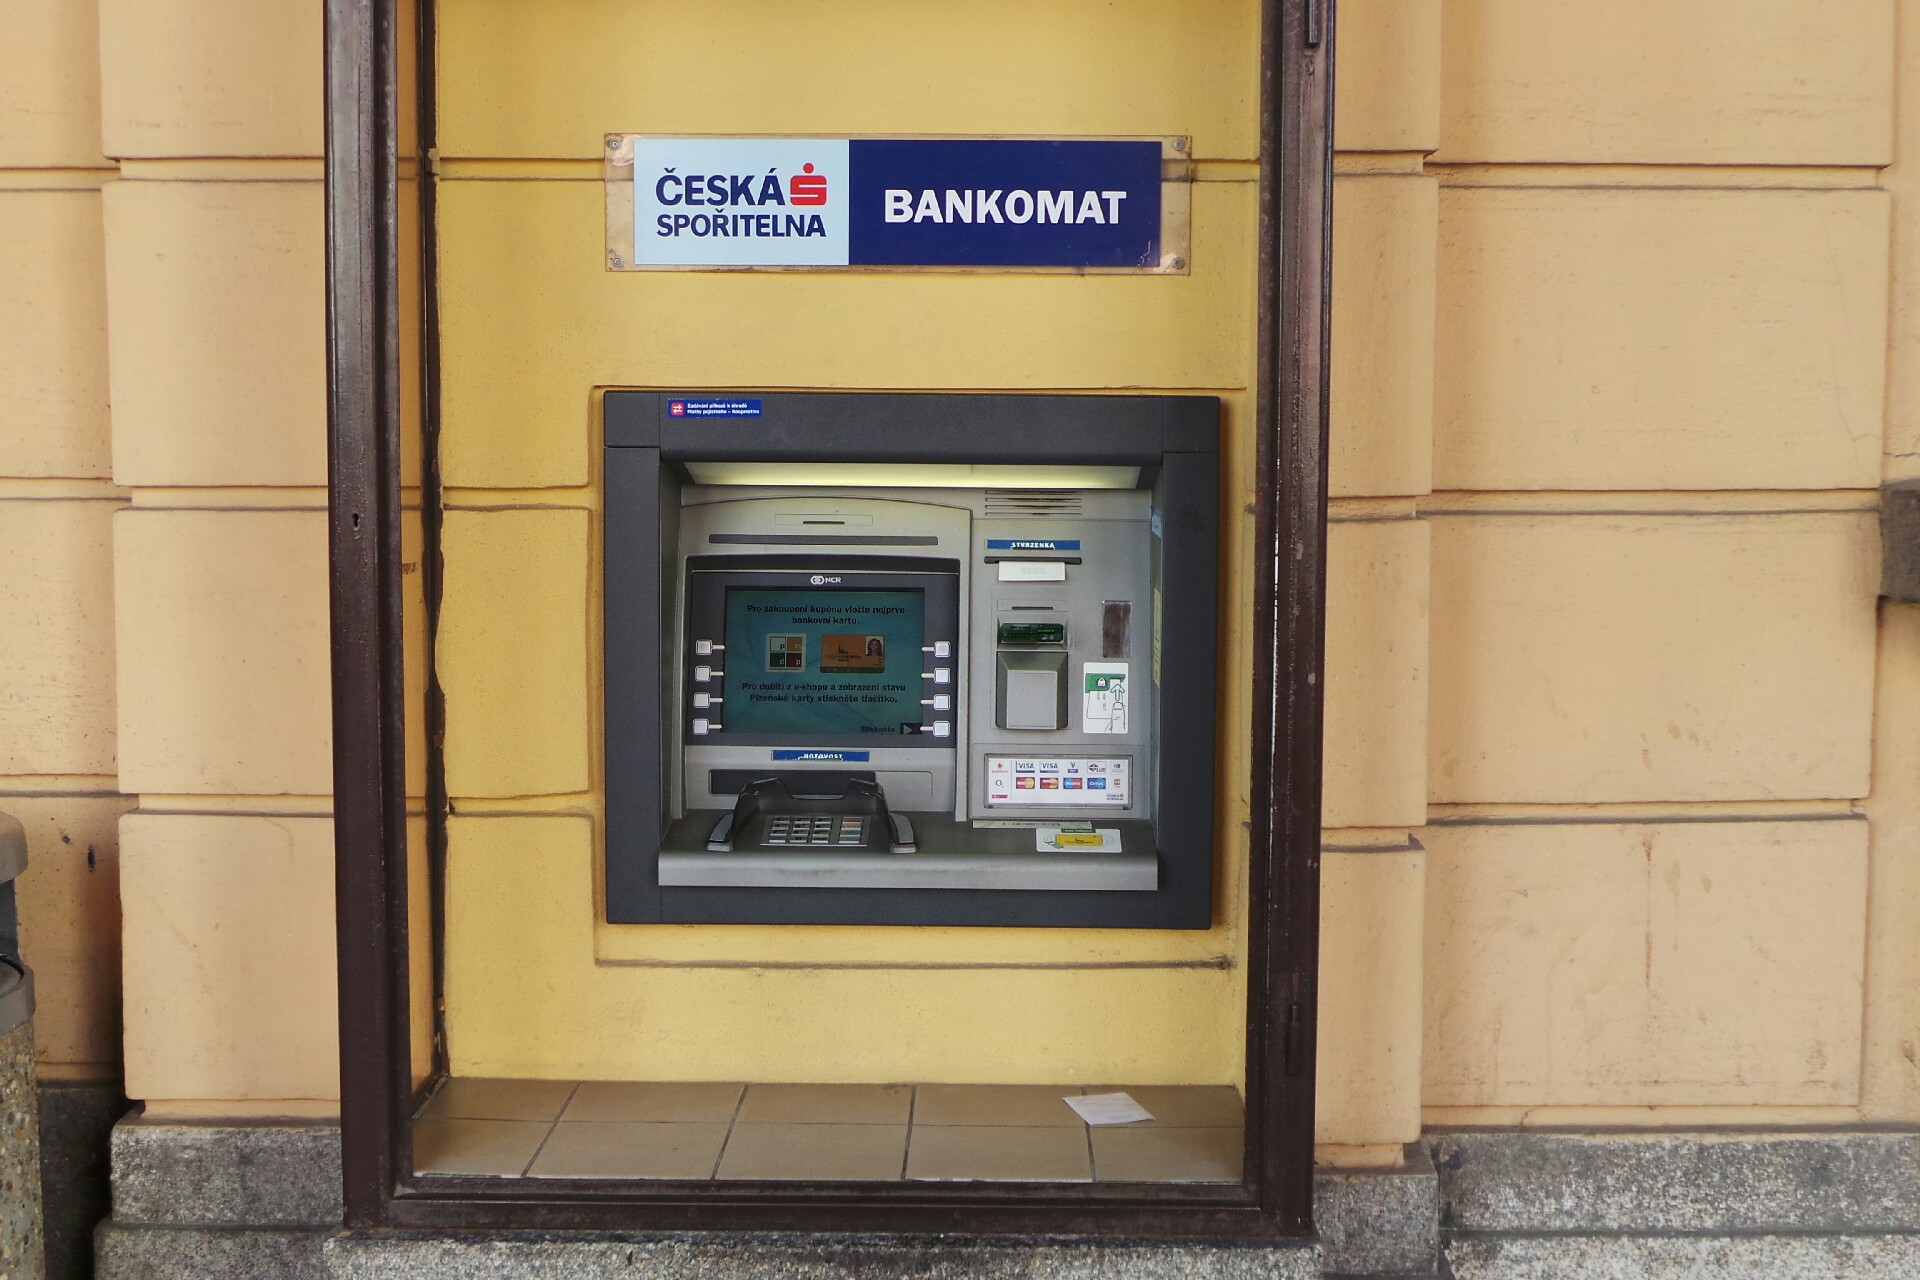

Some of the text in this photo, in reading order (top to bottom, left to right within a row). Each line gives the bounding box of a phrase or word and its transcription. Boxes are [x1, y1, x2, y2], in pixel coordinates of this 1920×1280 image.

[655, 167, 785, 206] ČESKÁ
[884, 189, 1127, 225] BANKOMAT
[655, 208, 827, 238] SPOŘITELNA
[825, 576, 842, 584] NCR
[747, 604, 905, 615] Pro zakoupení kupónu vložte nejprve
[792, 617, 831, 625] bankovní
[742, 682, 757, 691] Pro
[759, 682, 785, 691] dobití
[794, 682, 828, 692] e-shopu
[838, 682, 880, 691] zobrazení
[881, 683, 906, 691] stavu
[750, 694, 898, 704] Plzeňské karty stiskněte tlačítko.
